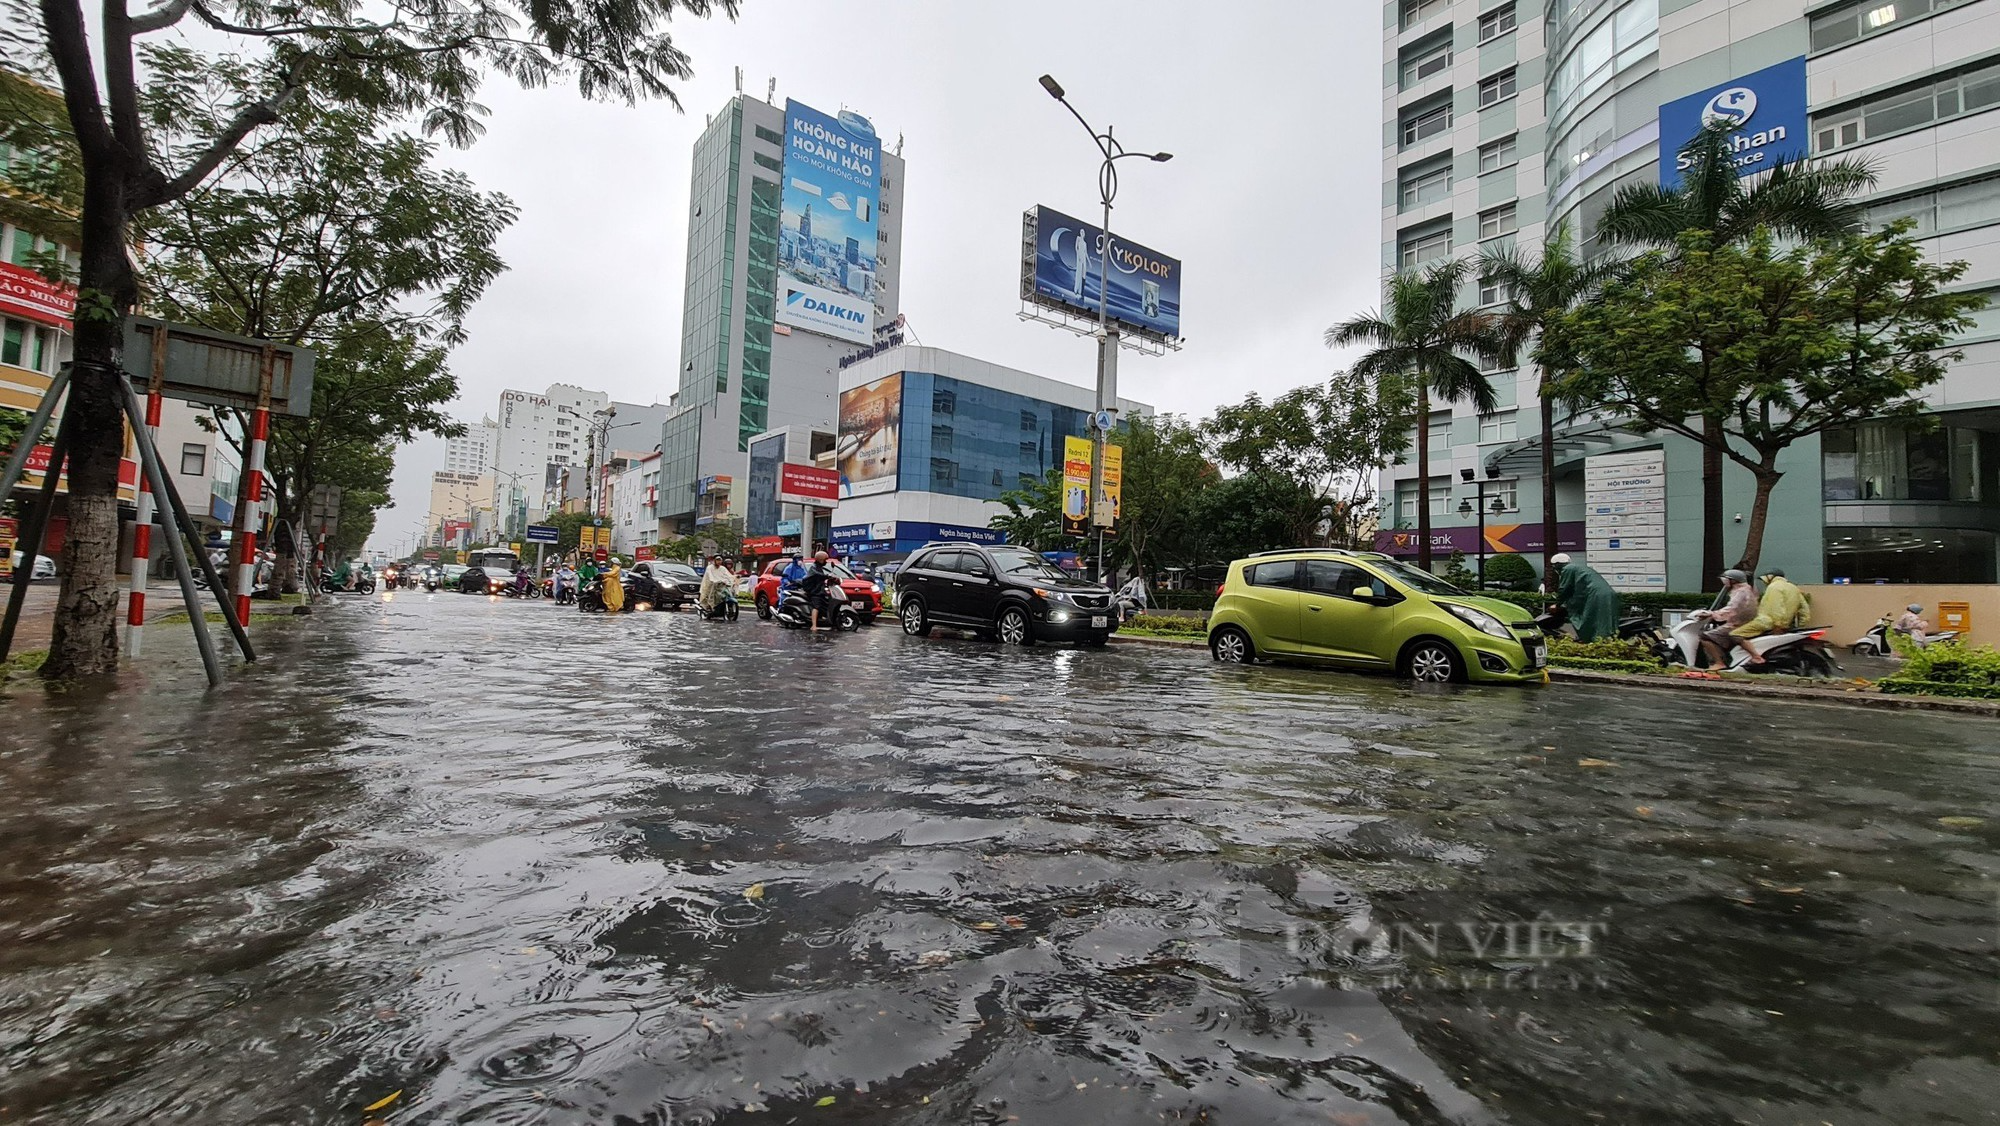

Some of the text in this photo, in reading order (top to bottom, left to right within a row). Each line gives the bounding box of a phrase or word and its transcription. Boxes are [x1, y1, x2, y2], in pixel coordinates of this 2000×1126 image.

[793, 117, 873, 161] KHÔNG KHÍ
[792, 135, 872, 177] HOÀN HẢO
[792, 152, 872, 189] CHO MỌI KHÔNG GIAN
[1095, 233, 1169, 279] SYKOLOR
[0, 279, 27, 295] ẢO
[29, 289, 70, 308] MINH
[803, 297, 865, 324] DAIKIN
[505, 392, 525, 402] DO
[505, 401, 513, 429] HOTEL
[1068, 448, 1082, 456] Redmi
[1607, 478, 1651, 487] HỘI TRƯỜNG
[939, 528, 955, 537] Ngân
[956, 530, 971, 539] hàng
[984, 532, 995, 541] Việt
[1409, 533, 1452, 546] Tank
